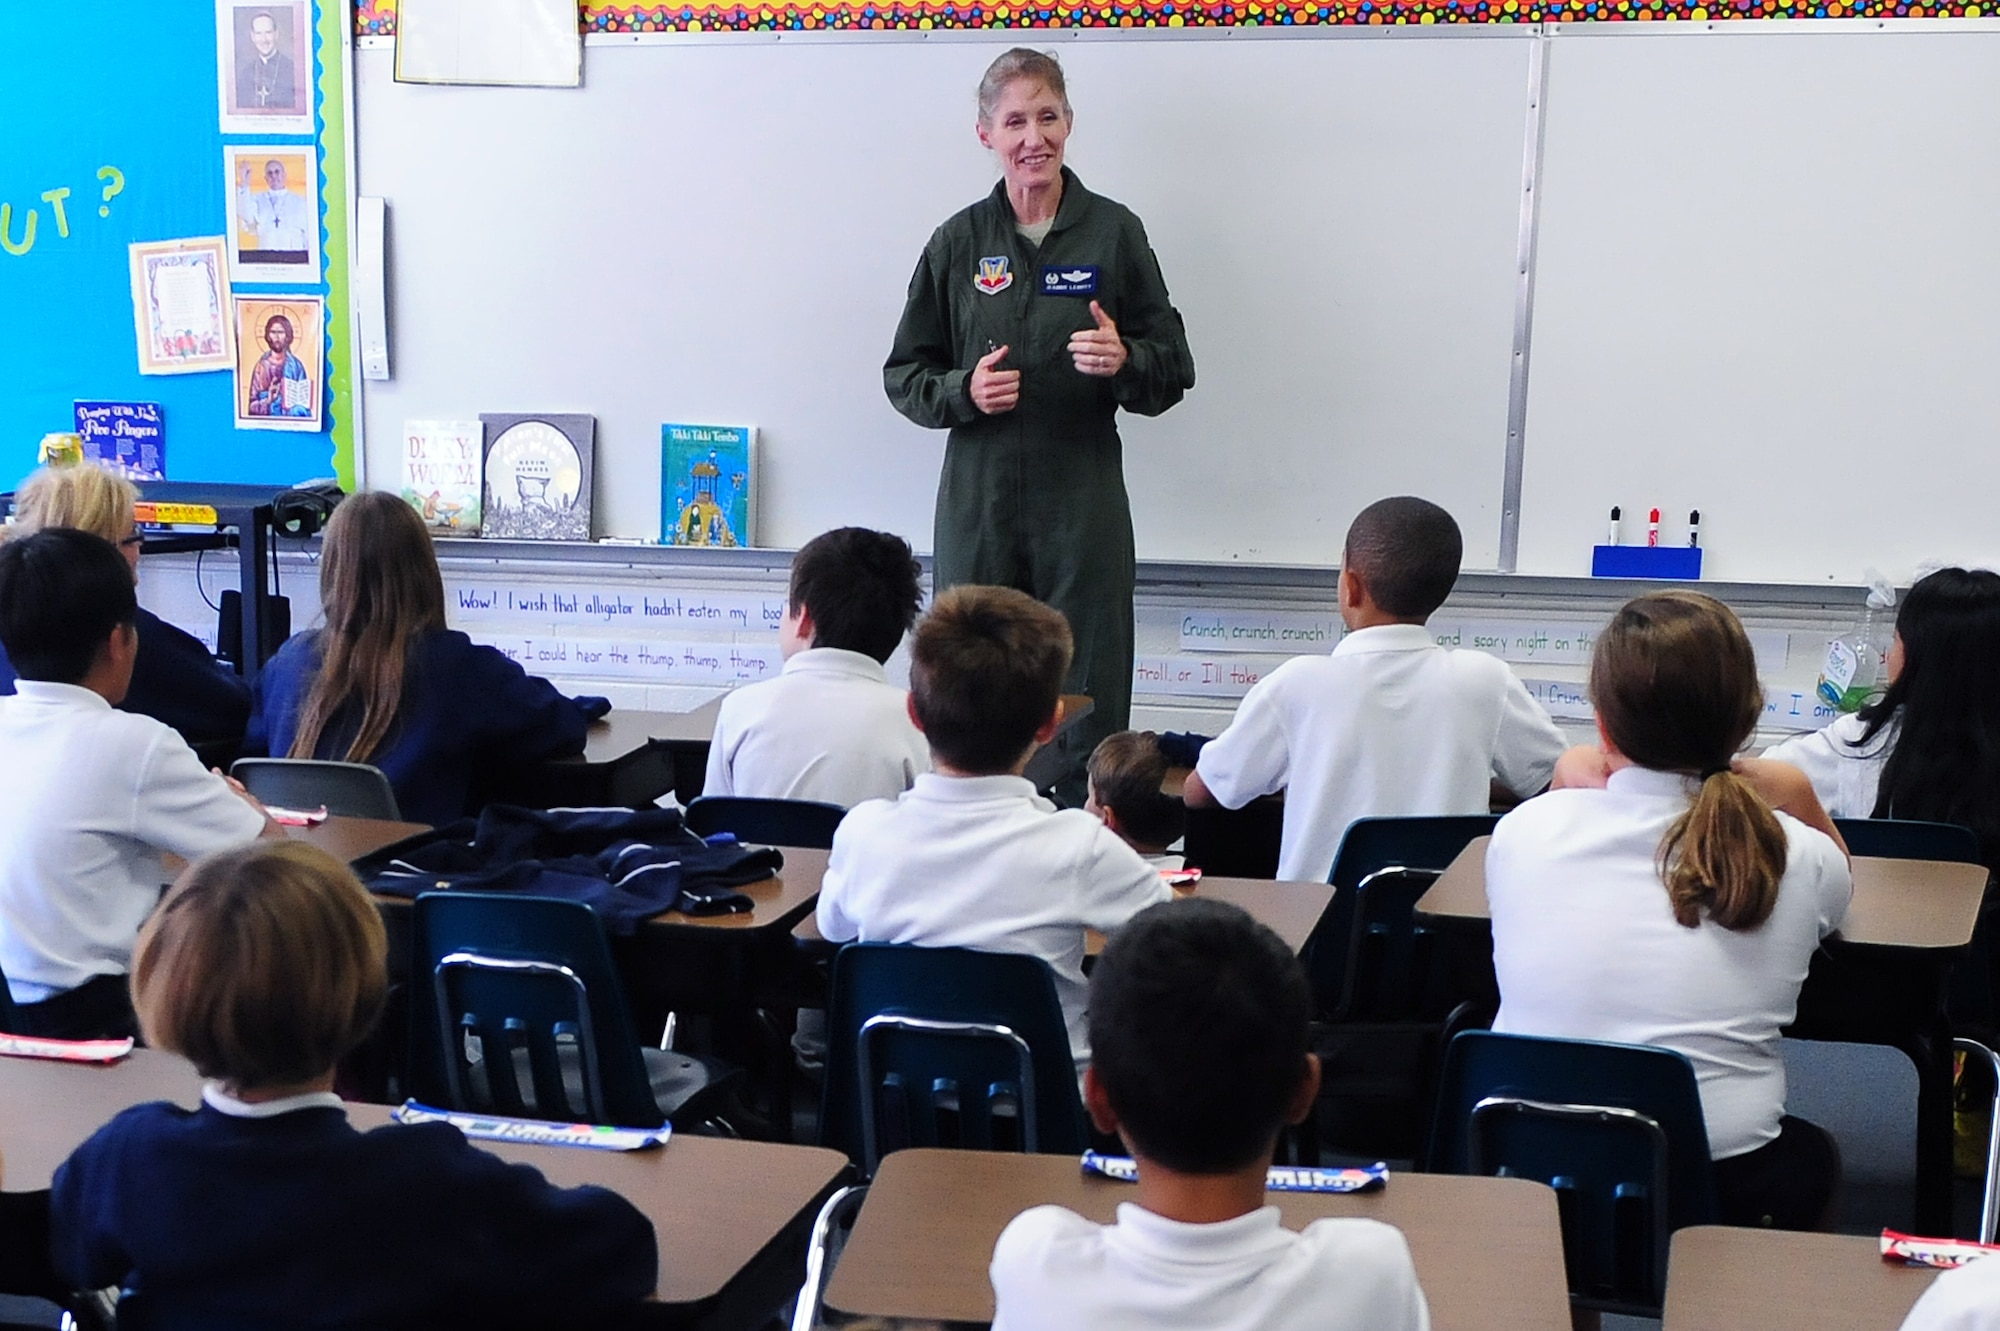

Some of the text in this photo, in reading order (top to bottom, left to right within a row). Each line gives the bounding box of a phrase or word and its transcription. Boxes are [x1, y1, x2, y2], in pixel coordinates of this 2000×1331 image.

[80, 419, 158, 439] Five Fingers
[459, 589, 497, 609] Wow!
[509, 591, 513, 610] I
[519, 593, 548, 612] wish
[553, 593, 578, 613] that
[585, 595, 633, 621] alligator
[688, 600, 721, 619] eaten
[729, 608, 748, 627] my
[524, 640, 533, 659] I
[538, 643, 567, 661] could
[576, 643, 602, 663] hear
[608, 645, 629, 663] the
[1436, 628, 1461, 646] and
[1473, 636, 1508, 649] scary
[1516, 630, 1548, 656] night
[1555, 636, 1569, 650] on
[1577, 631, 1591, 650] th
[1178, 671, 1192, 681] or
[1202, 663, 1222, 683] I'll
[1230, 664, 1258, 684] take
[1789, 694, 1802, 715] I
[1813, 706, 1836, 718] am
